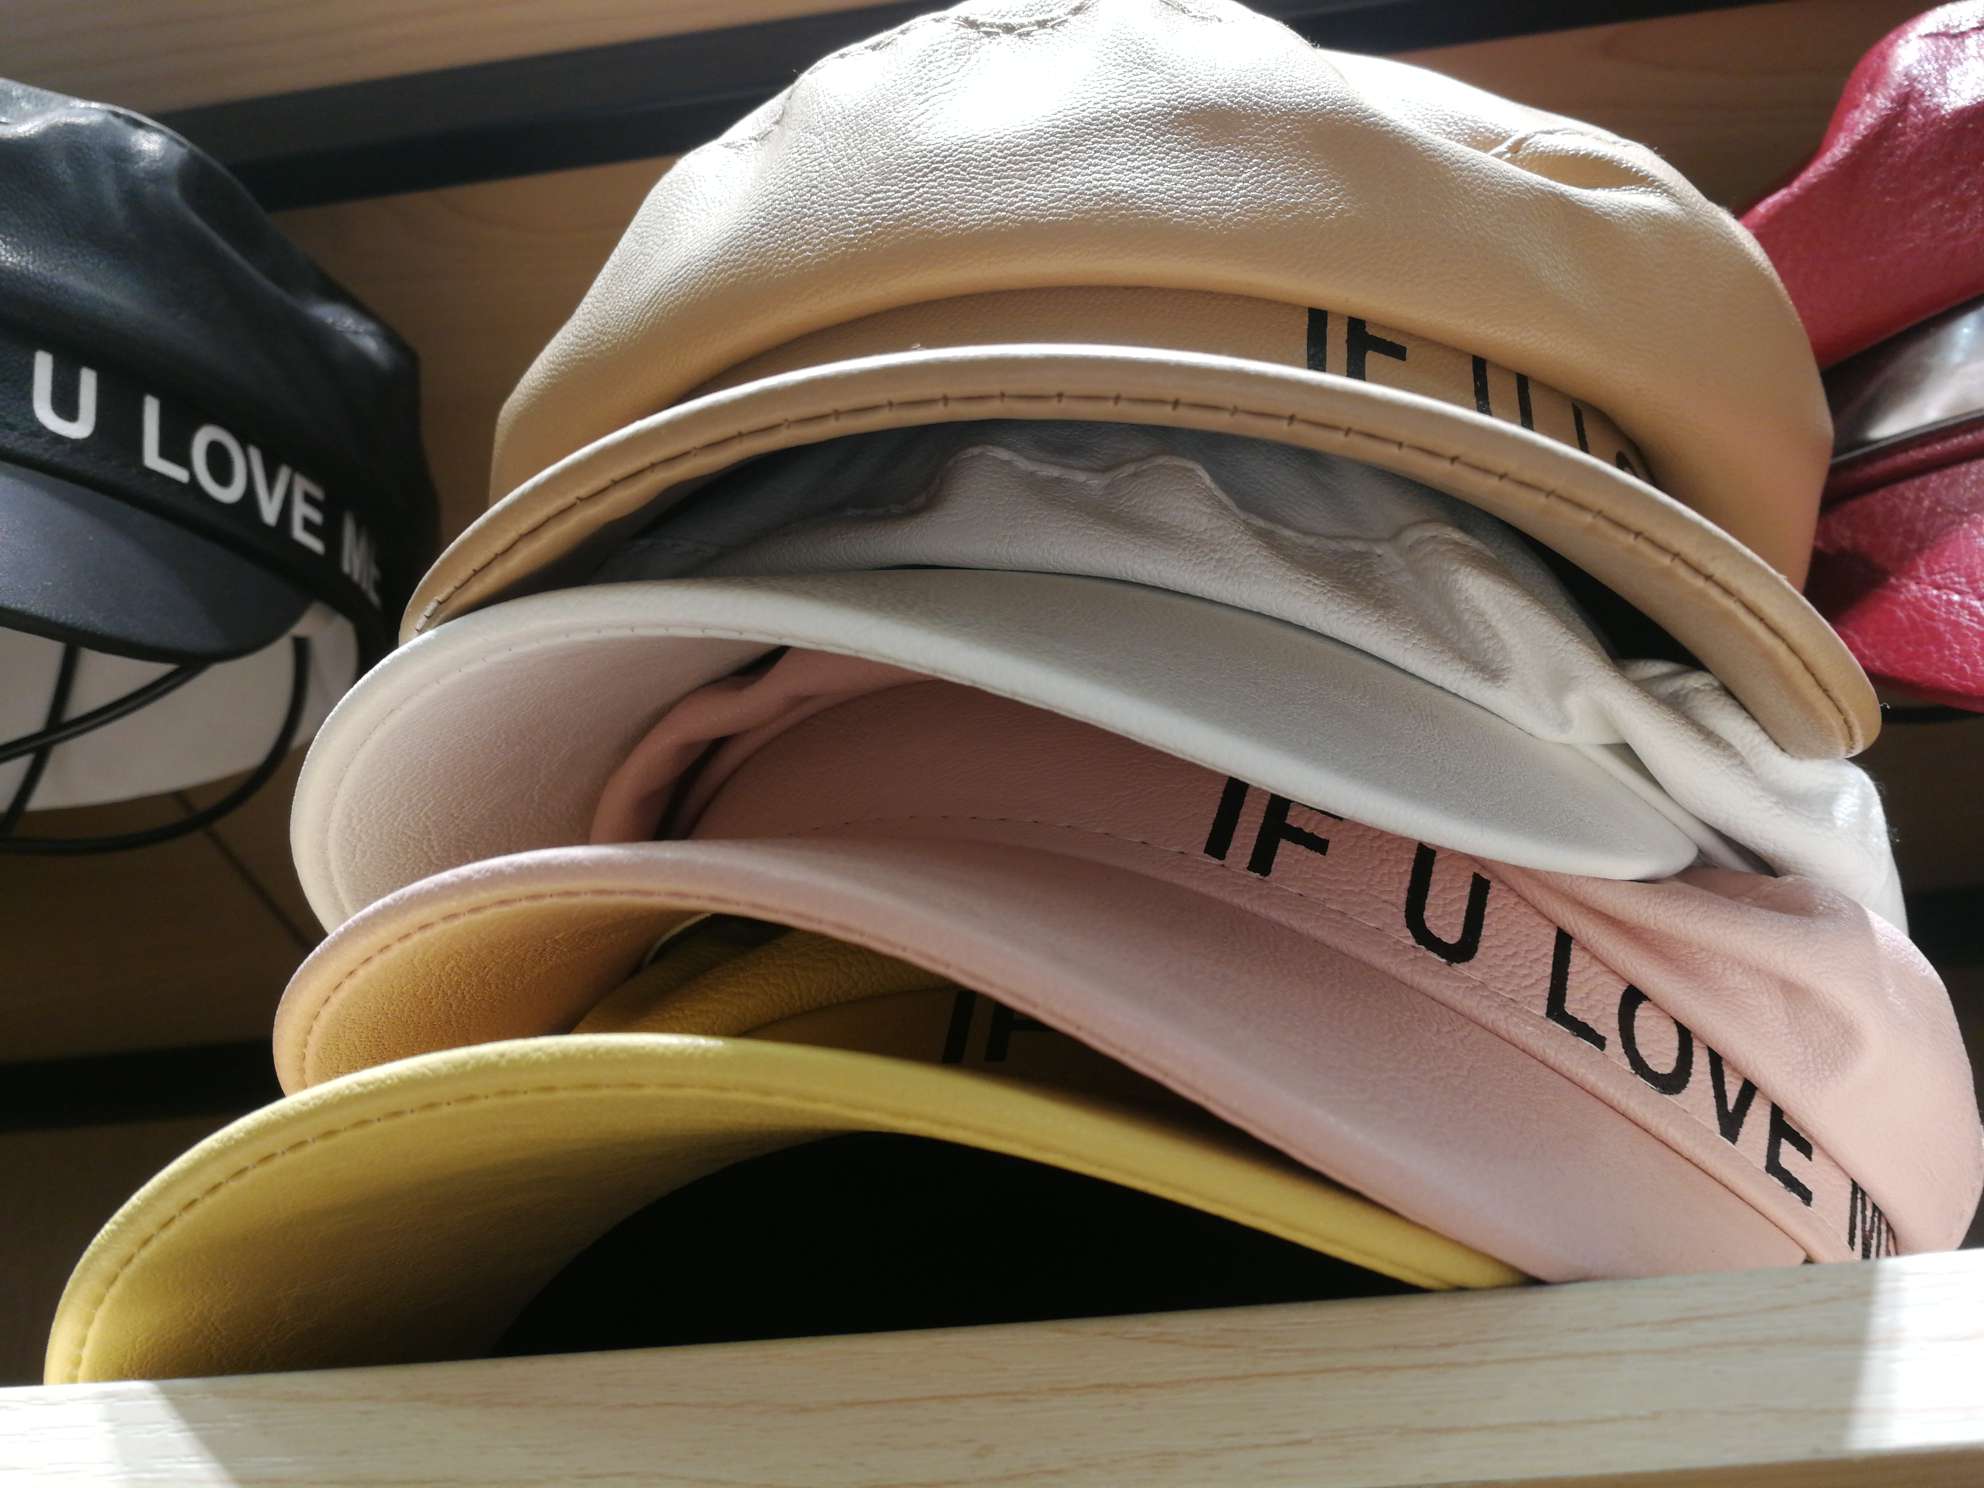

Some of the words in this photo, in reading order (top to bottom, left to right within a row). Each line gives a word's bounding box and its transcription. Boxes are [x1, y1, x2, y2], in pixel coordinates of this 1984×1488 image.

[33, 350, 97, 440] U
[143, 394, 325, 555] LOVE
[1203, 776, 1343, 877] IF
[1405, 842, 1491, 965] U
[1546, 927, 1813, 1208] LOVE
